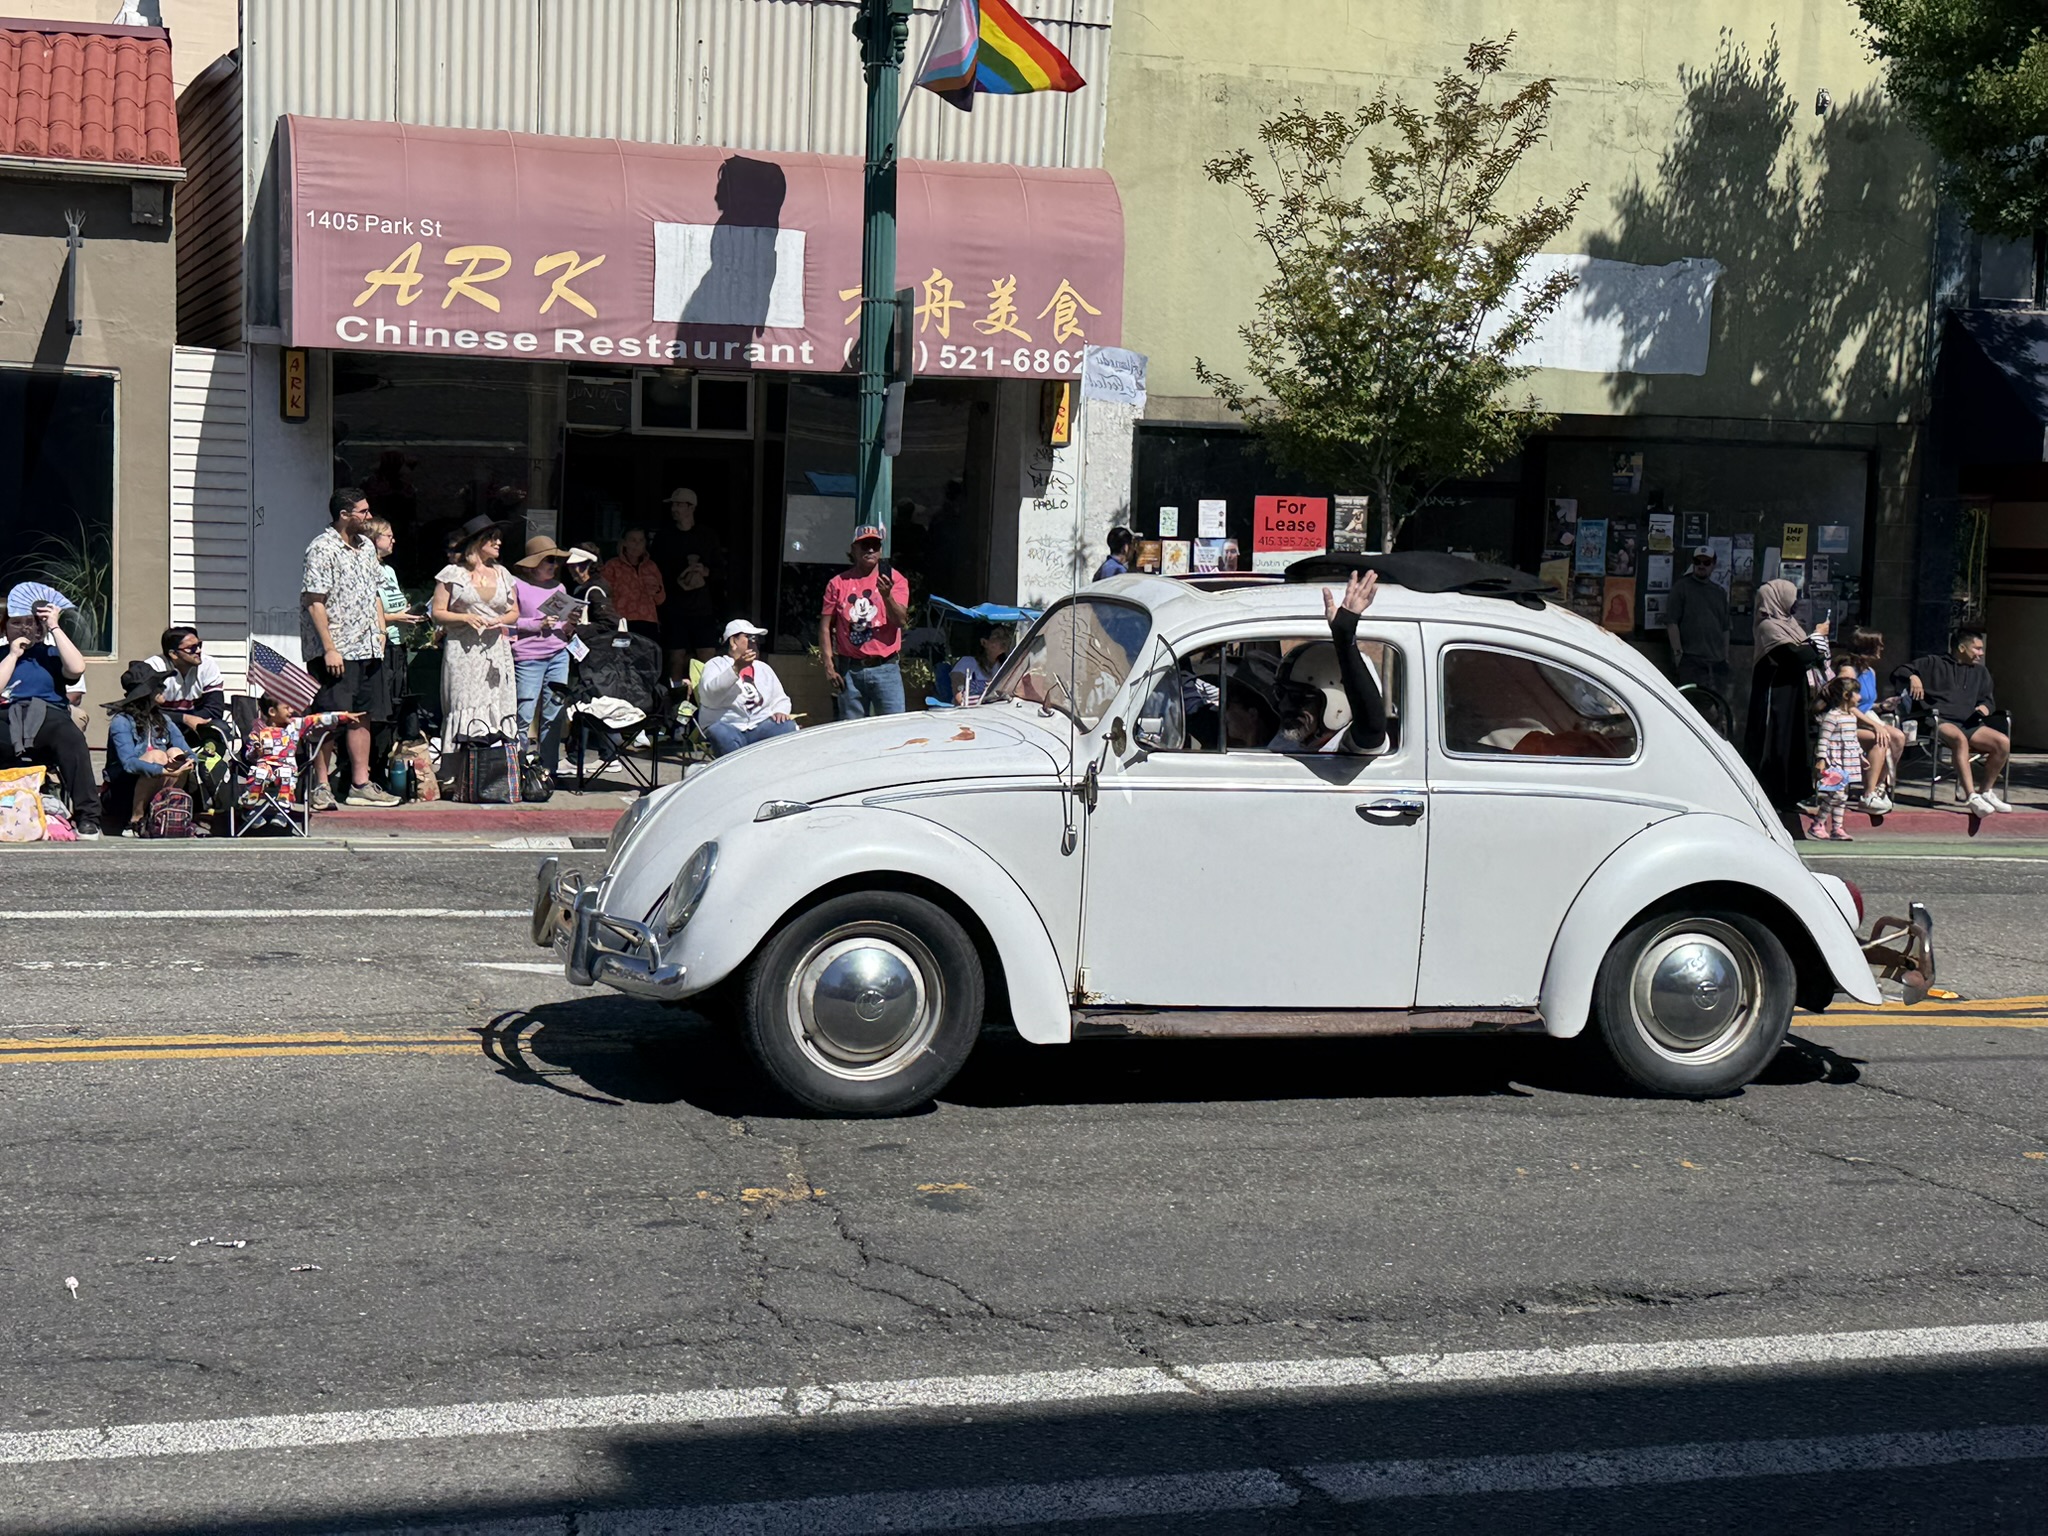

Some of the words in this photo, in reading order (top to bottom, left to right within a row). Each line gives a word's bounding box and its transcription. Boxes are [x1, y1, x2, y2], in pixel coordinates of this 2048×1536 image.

[306, 210, 359, 231] 1405
[364, 215, 415, 235] Park
[419, 219, 443, 237] St
[352, 241, 606, 319] ARK
[335, 316, 538, 349] Chinese
[554, 328, 815, 365] Restaurant
[289, 357, 302, 409] ARK
[1276, 499, 1307, 515] For
[1264, 515, 1317, 533] Lease
[1258, 536, 1322, 548] 415.395.7262
